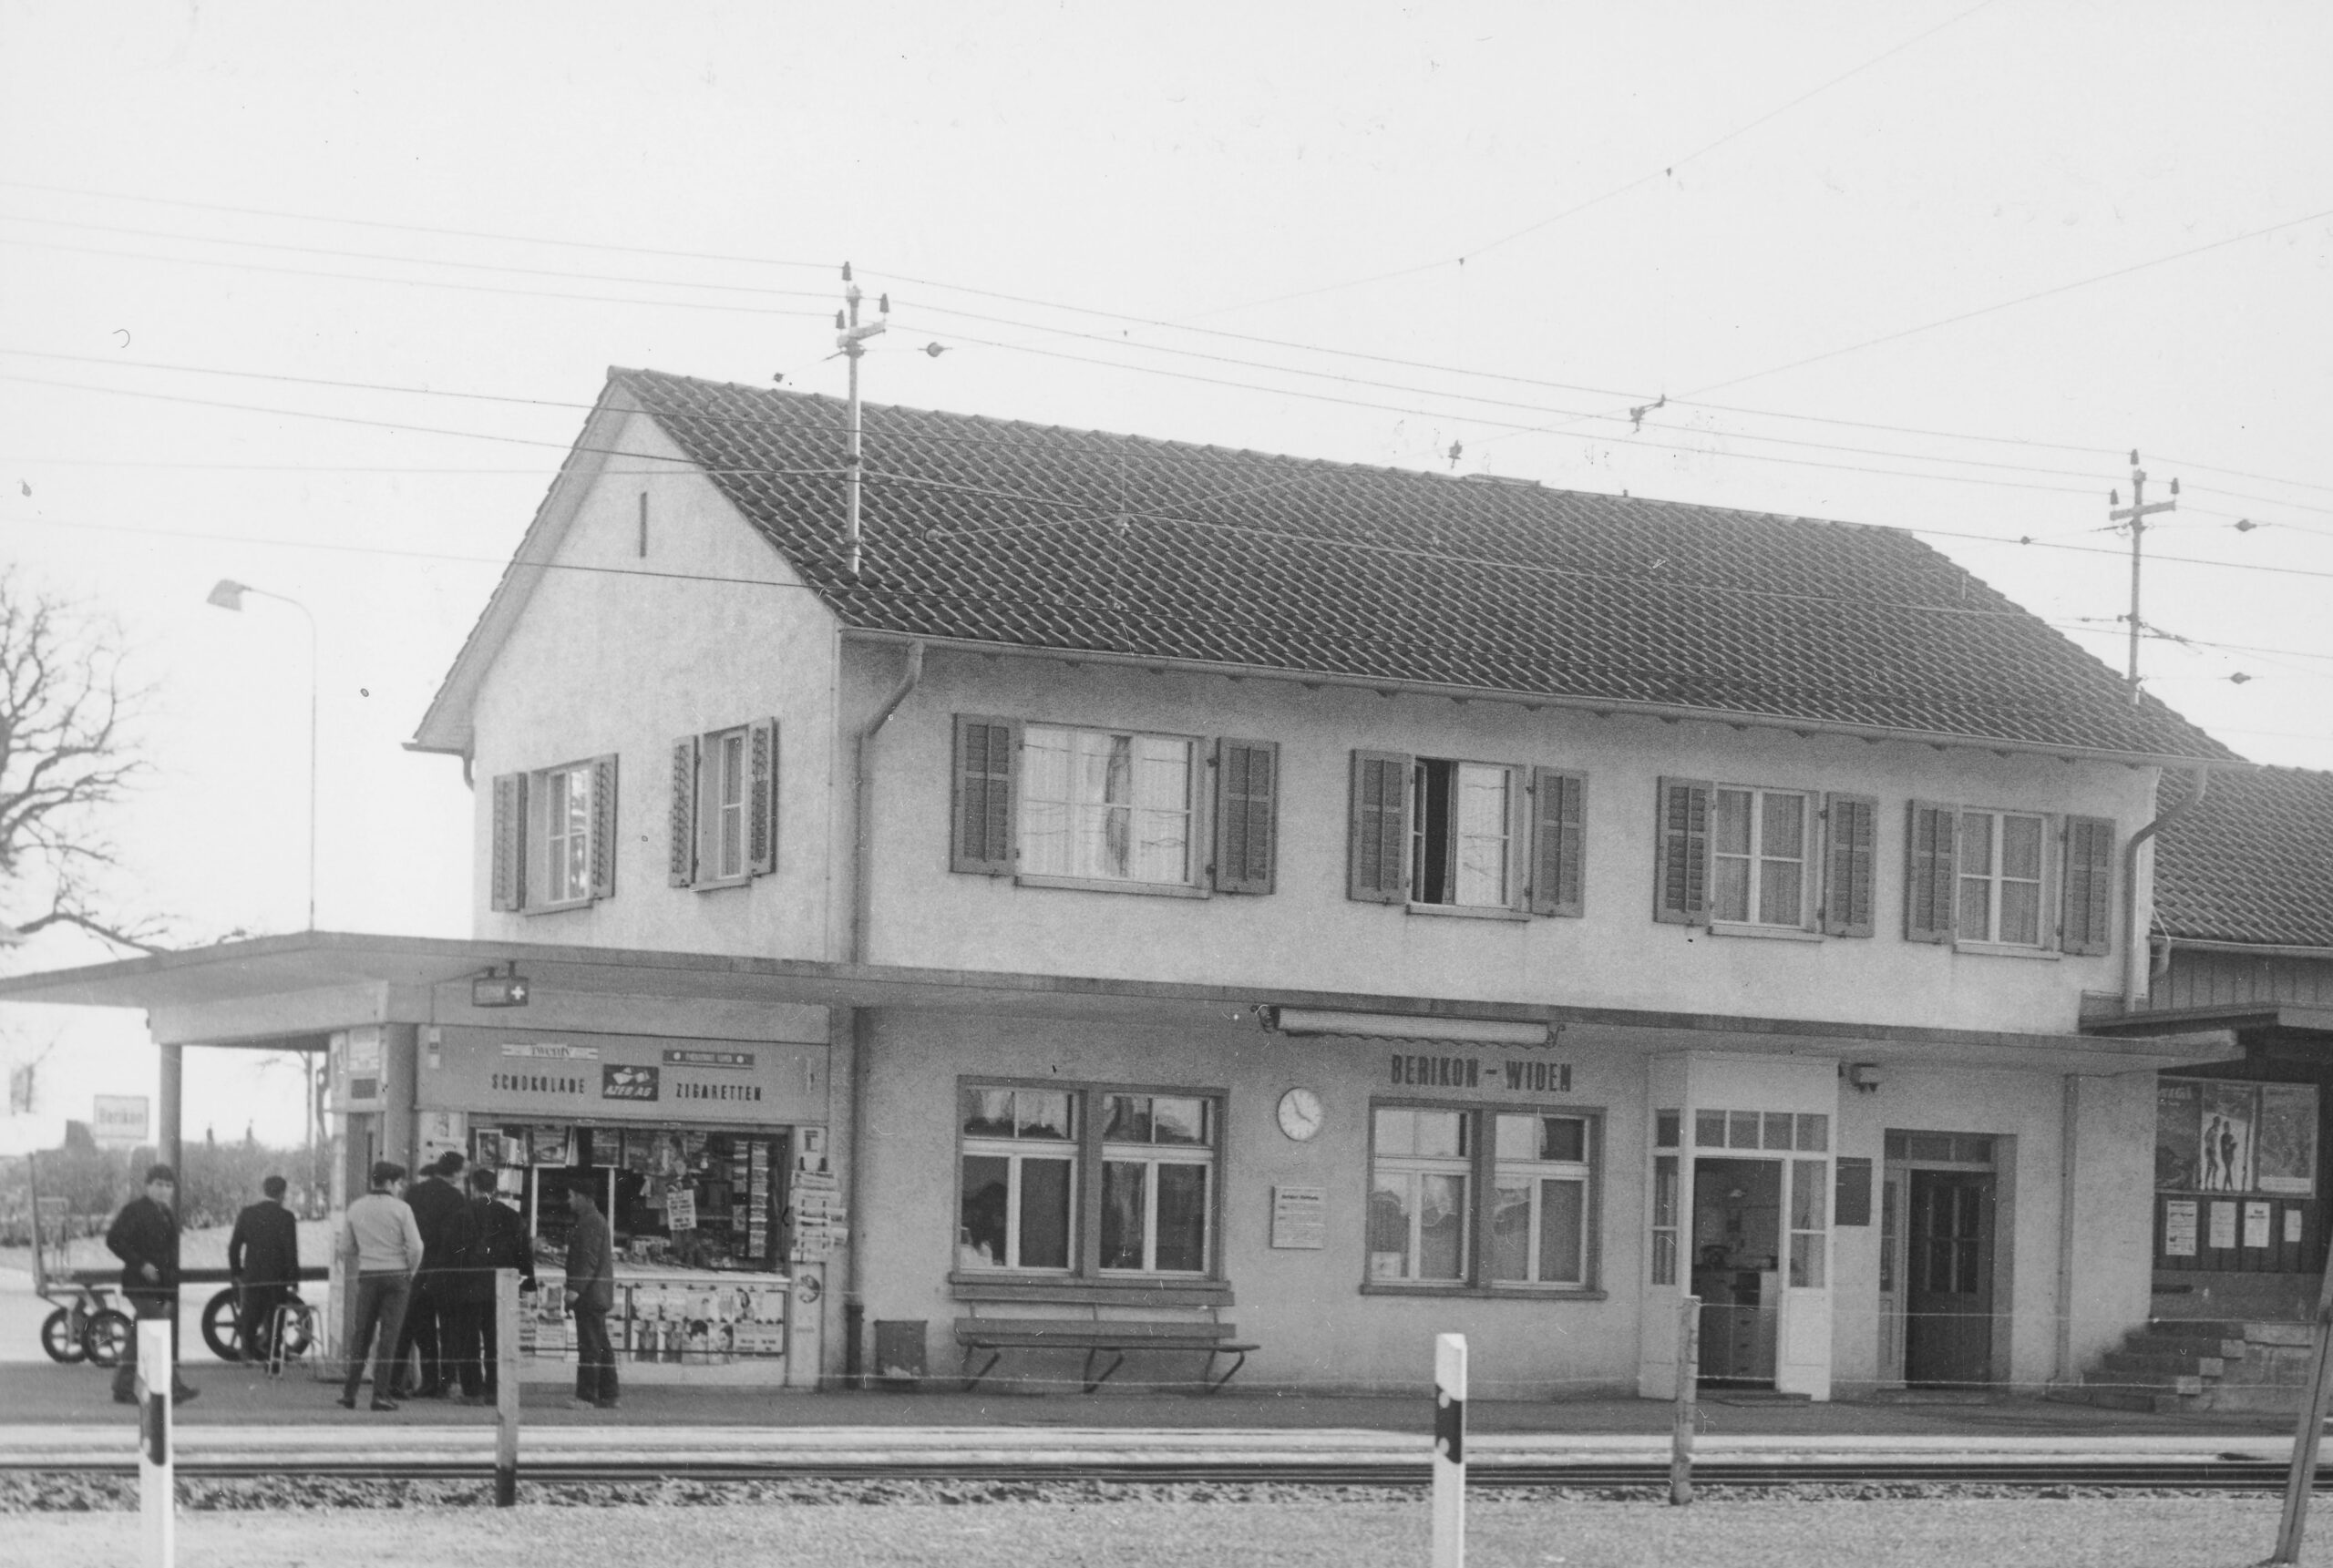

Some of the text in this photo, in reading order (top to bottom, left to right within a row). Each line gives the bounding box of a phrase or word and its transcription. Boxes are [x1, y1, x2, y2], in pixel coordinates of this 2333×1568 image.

[492, 1073, 584, 1094] SCHOKOLADE
[1391, 1054, 1478, 1088] BERIKON
[1506, 1060, 1571, 1092] WIDEN
[676, 1082, 761, 1102] ZIGARETTEN
